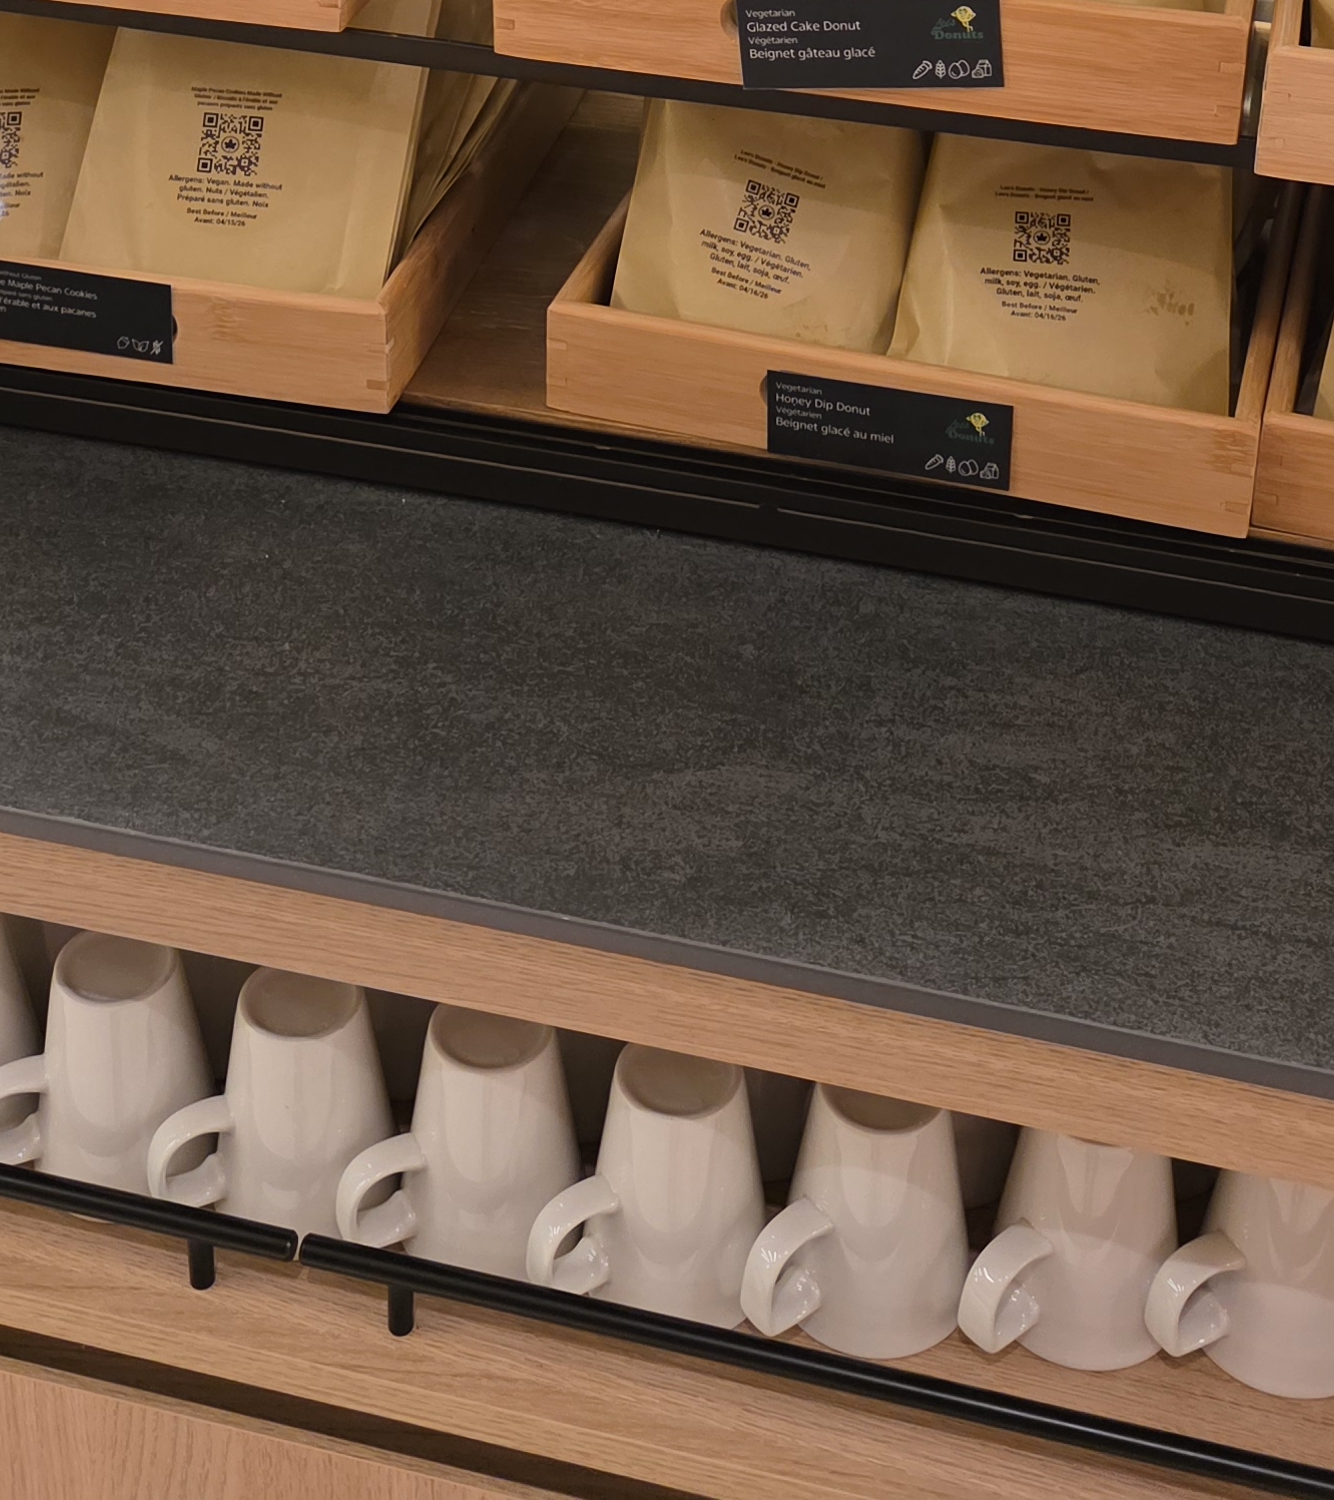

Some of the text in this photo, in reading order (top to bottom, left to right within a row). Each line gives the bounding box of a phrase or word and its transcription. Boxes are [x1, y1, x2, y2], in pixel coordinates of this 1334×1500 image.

[745, 9, 795, 19] Vegetarian
[747, 20, 861, 32] Glazed Cake Donut
[748, 36, 798, 46] Végétarien
[930, 30, 984, 40] Donuts
[749, 47, 875, 61] Beignet gâteau glacé
[776, 393, 870, 416] Honey Dip Donut
[776, 416, 894, 443] Beignet glacé au miel
